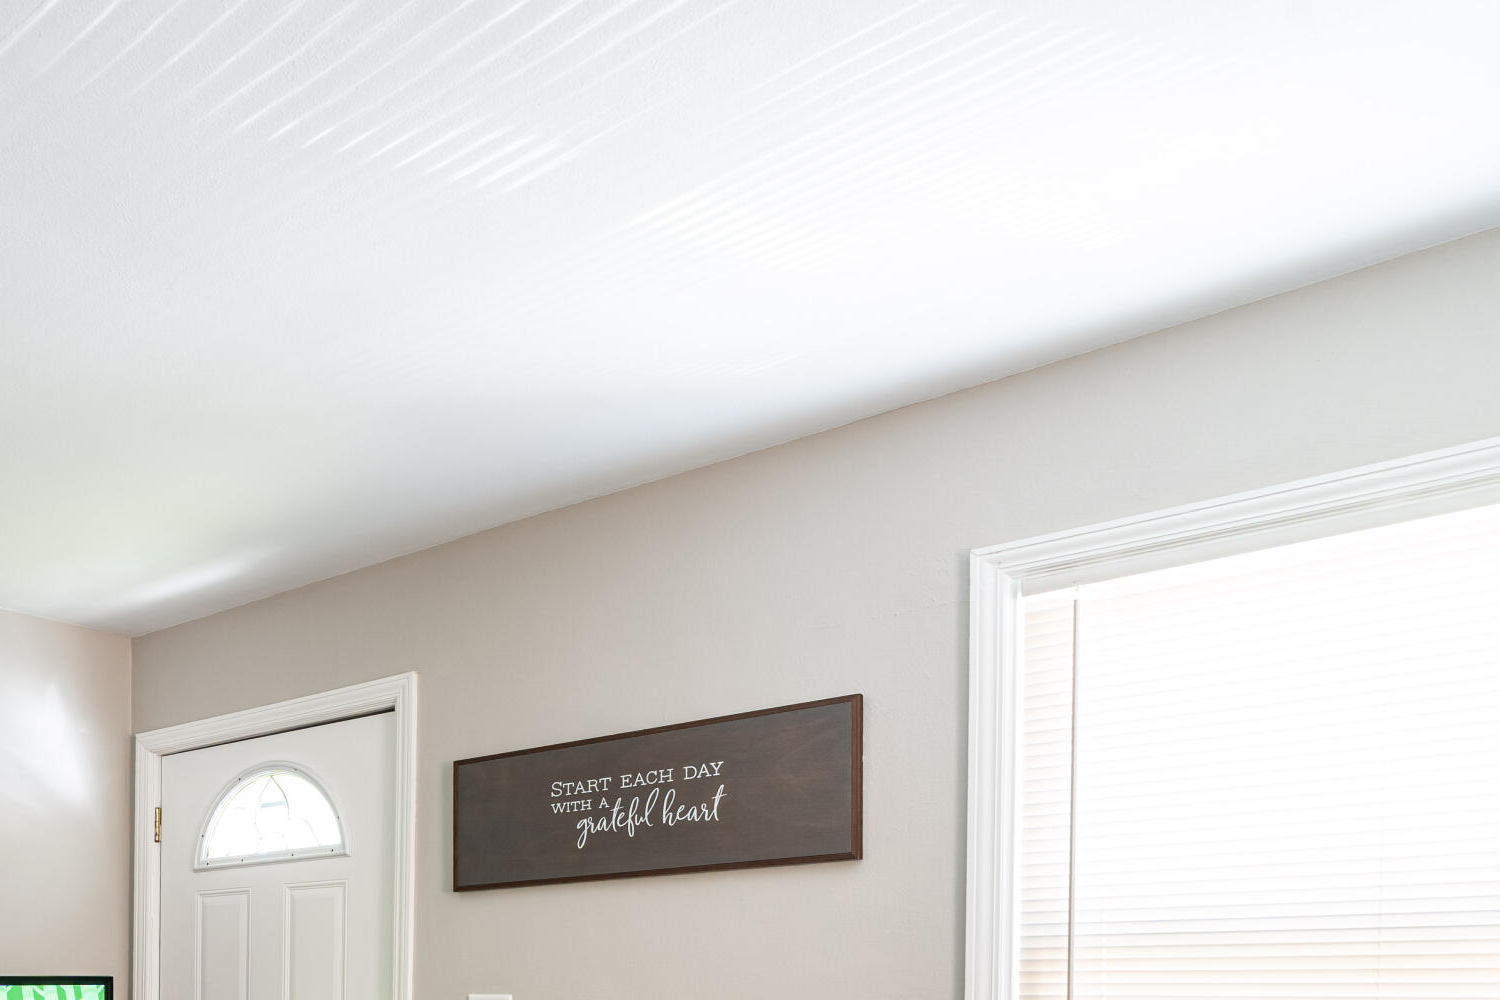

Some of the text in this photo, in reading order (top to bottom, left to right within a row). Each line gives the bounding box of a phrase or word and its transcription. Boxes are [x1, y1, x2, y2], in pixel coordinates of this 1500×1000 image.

[550, 761, 725, 797] START EACH DAY
[550, 797, 610, 814] WITH A
[576, 784, 728, 849] grateful heart
